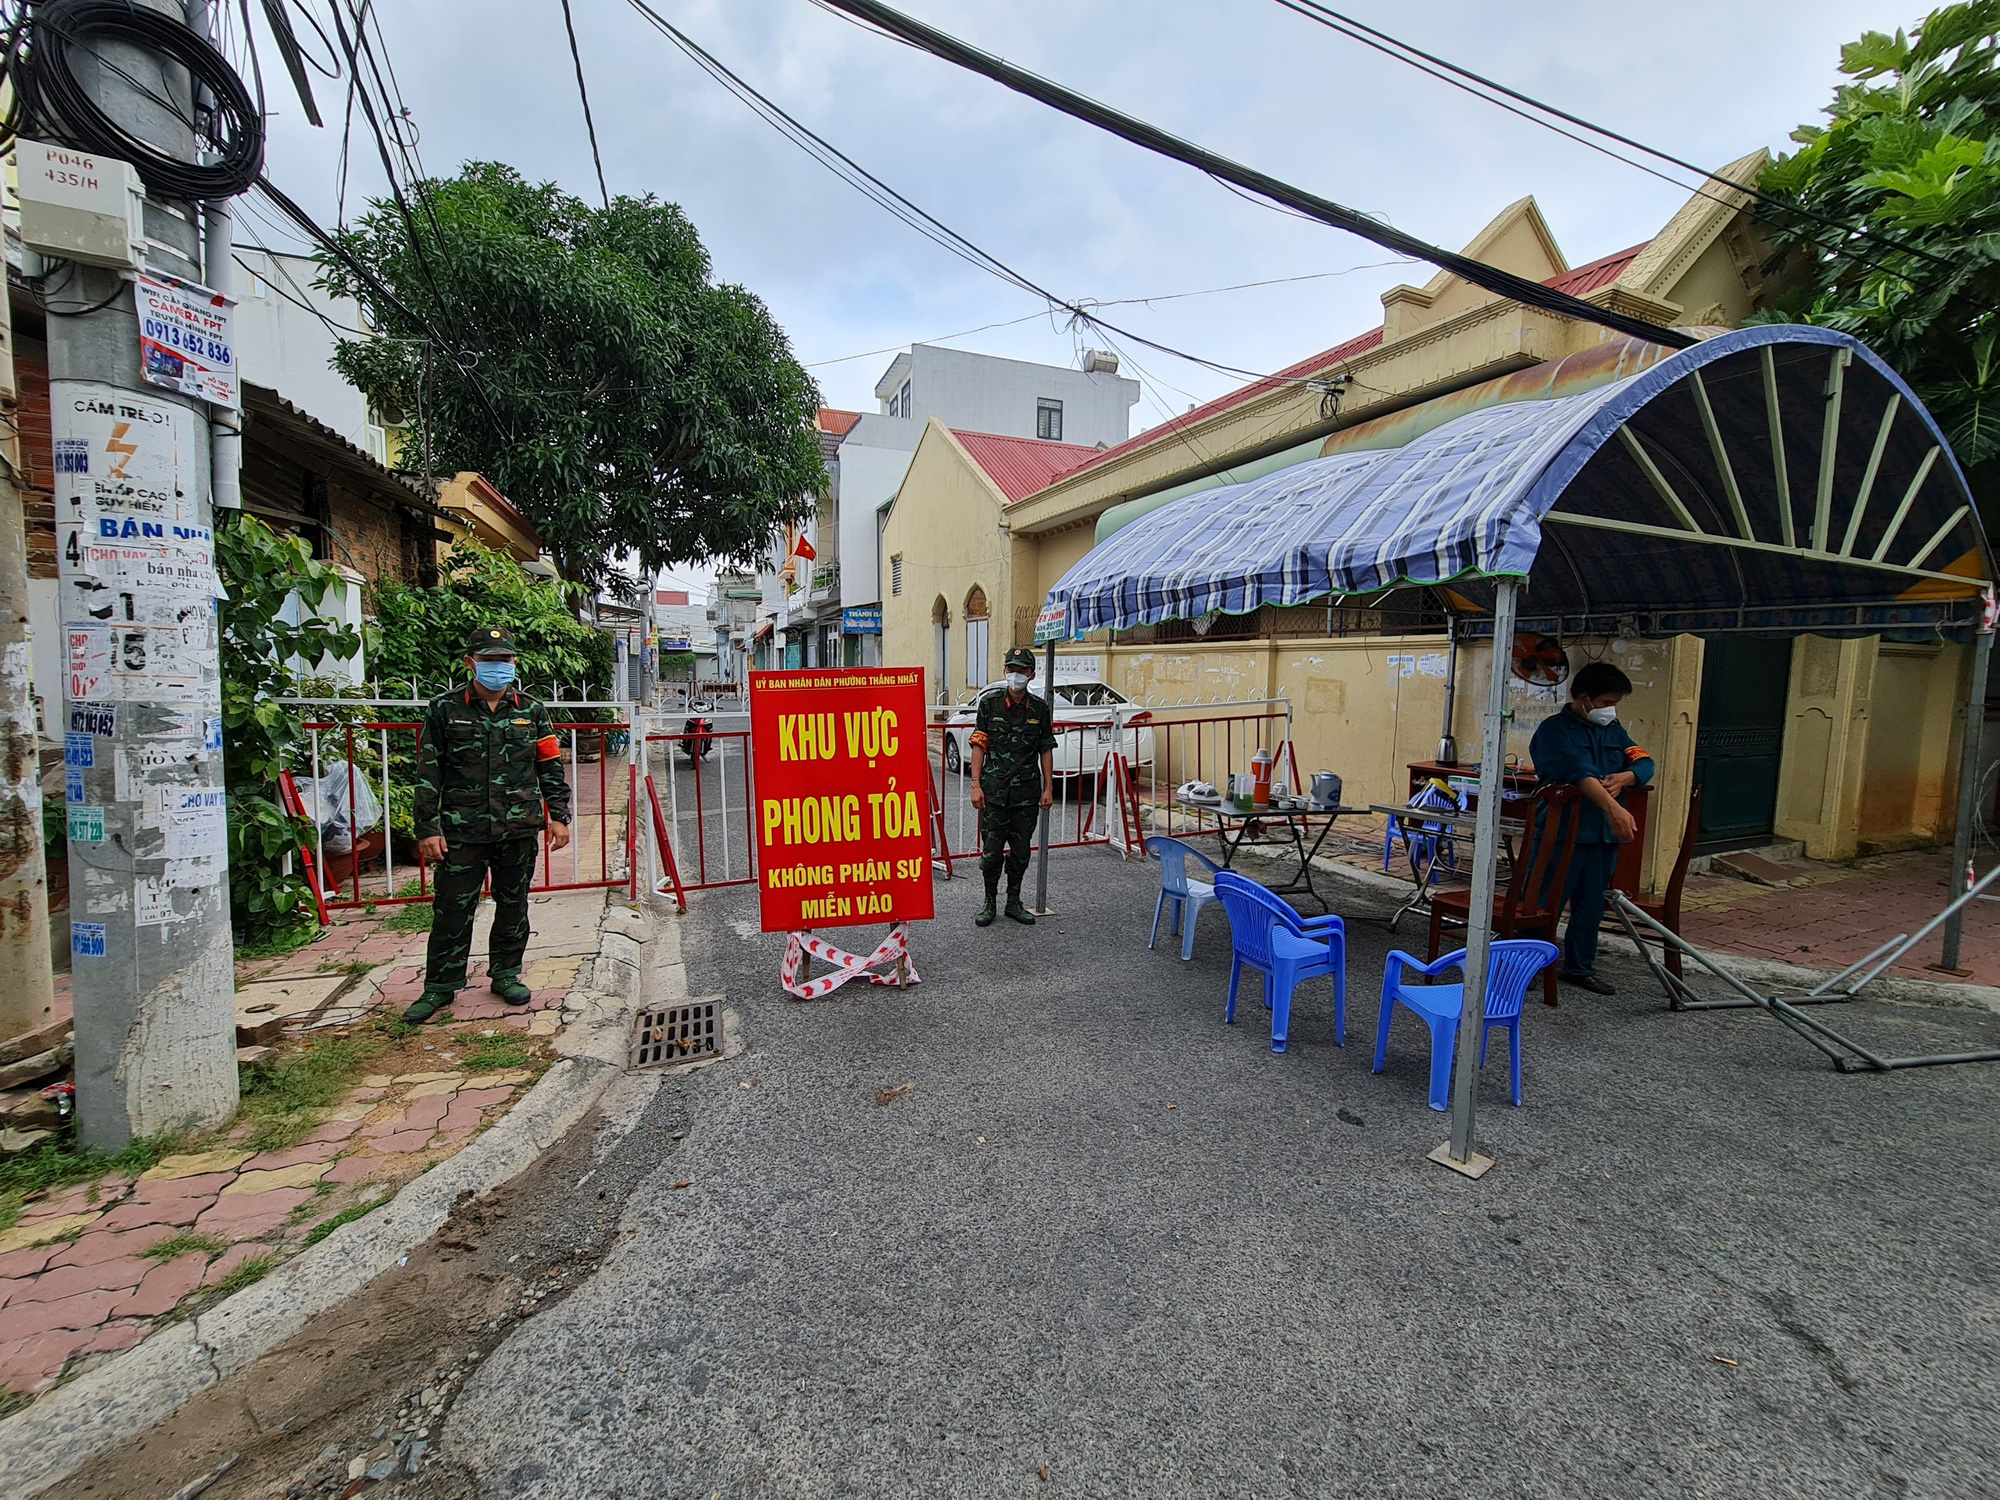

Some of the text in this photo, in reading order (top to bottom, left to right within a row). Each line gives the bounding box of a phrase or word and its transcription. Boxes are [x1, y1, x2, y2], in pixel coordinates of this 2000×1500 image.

[46, 149, 94, 171] P046
[44, 168, 98, 190] 435/H
[141, 286, 161, 299] WIFI
[182, 302, 212, 319] QUANG
[214, 313, 227, 324] FPT
[148, 298, 222, 332] CAMERA FPT
[146, 318, 230, 364] 0913 652 836
[209, 331, 223, 341] FPT
[74, 397, 114, 416] CẤM
[95, 496, 125, 507] GUY
[137, 489, 168, 501] CAO
[100, 517, 163, 538] BÁN
[147, 562, 173, 576] bán
[769, 679, 787, 689] BAN
[788, 676, 812, 688] NHÂN
[814, 676, 832, 688] DÂN
[834, 674, 867, 687] PHƯỜNG
[869, 672, 896, 686] THẮNG
[897, 671, 919, 684] NHẤT
[778, 705, 899, 768] KHU VỰC
[204, 793, 218, 807] VAY
[763, 776, 922, 846] PHONG TỎA
[768, 857, 923, 888] KHÔNG PHẬN SỰ
[801, 891, 893, 920] MIỄN VÀO
